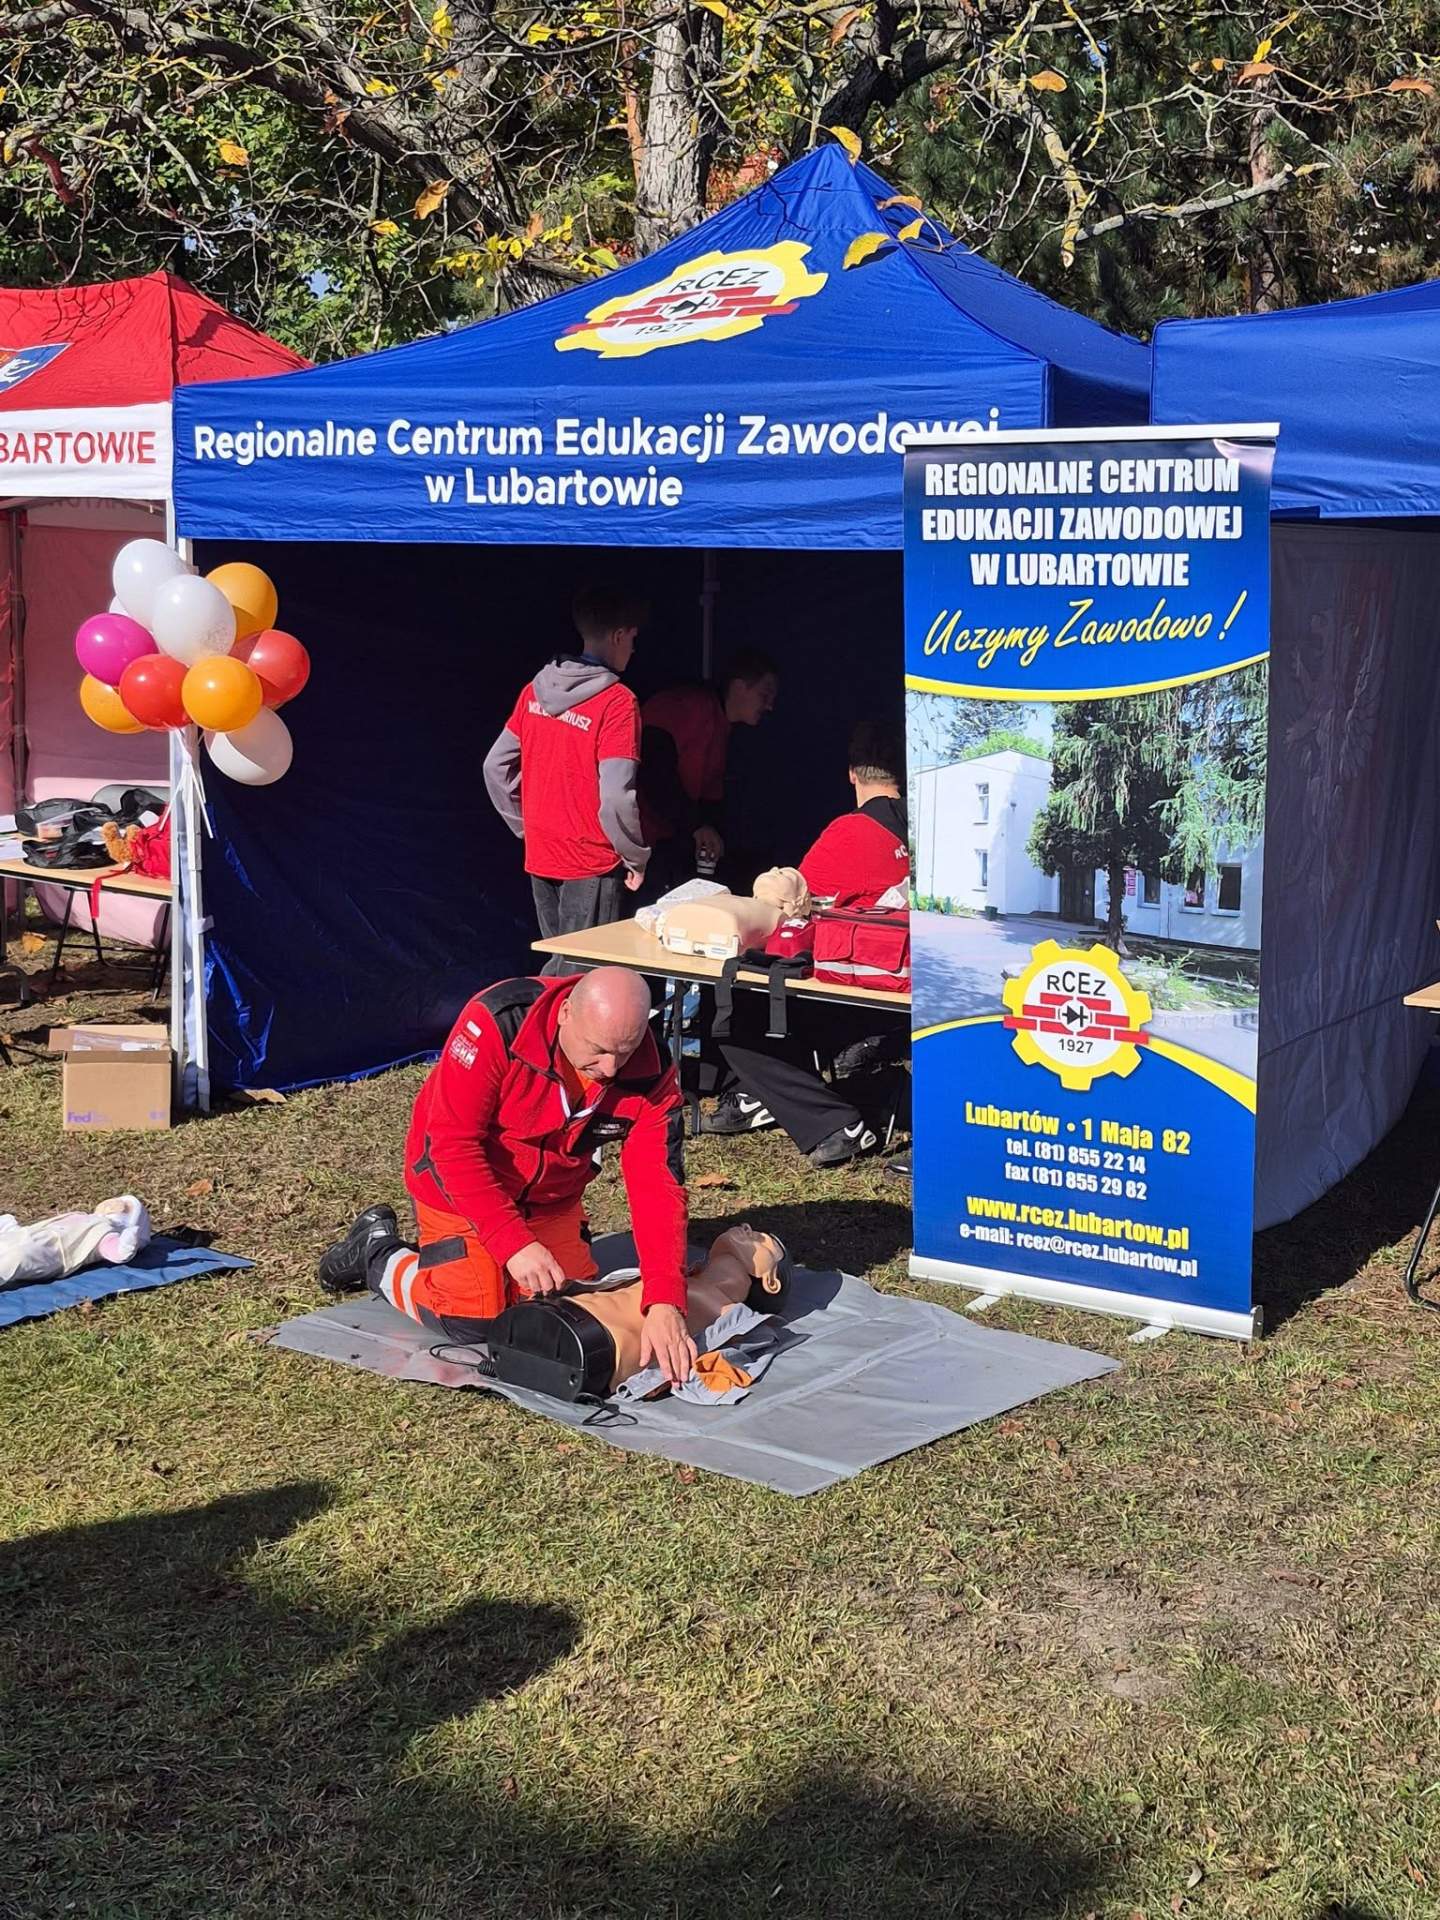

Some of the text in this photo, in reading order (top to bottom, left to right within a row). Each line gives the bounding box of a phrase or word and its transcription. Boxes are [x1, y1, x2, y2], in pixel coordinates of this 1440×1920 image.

[668, 267, 769, 294] RCEZ
[634, 322, 693, 336] 1927
[194, 420, 377, 466] Regionalne
[387, 418, 543, 456] Centrum
[555, 413, 725, 463] Edukacji
[424, 465, 683, 506] w Lubartowie
[925, 458, 1240, 496] REGIONALNE CENTRUM
[921, 505, 1243, 541] EDUKACJI ZAWODOWEJ
[970, 552, 1190, 587] W LUBARTOWIE
[923, 608, 1050, 670] Uczymy
[1053, 597, 1214, 649] Zawodowo
[1046, 970, 1106, 997] RCEZ
[1058, 1038, 1094, 1054] 1927
[965, 1102, 1060, 1135] Lubartów
[1101, 1120, 1154, 1149] Maja
[1162, 1129, 1191, 1154] 82
[1006, 1138, 1146, 1175] tel. (81) 855 22 14
[1005, 1162, 1147, 1200] fax (81) 855 29 82
[966, 1196, 1189, 1250] www.rcez.lubartow.pl
[959, 1223, 1198, 1277] e-mail: rcez@rcez.lubartow.pl
